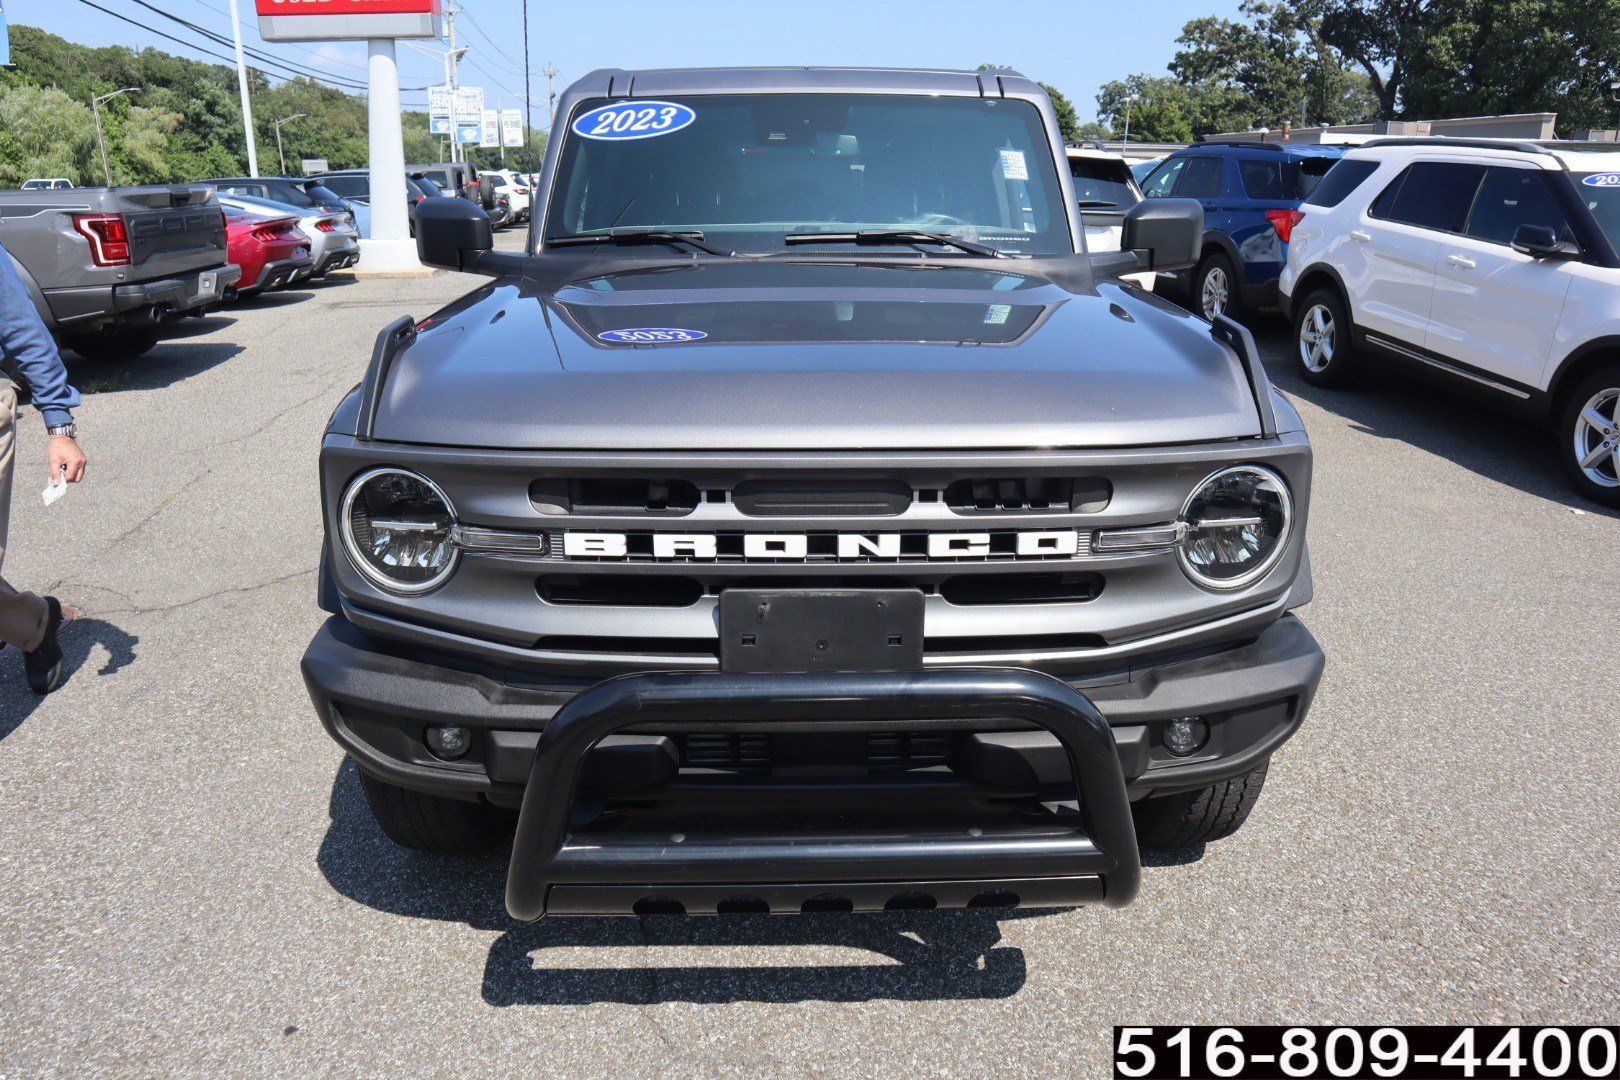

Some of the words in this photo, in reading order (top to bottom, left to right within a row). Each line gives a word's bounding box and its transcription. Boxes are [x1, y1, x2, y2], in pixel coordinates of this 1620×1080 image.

[590, 106, 678, 135] 2023
[1595, 174, 1620, 185] 20
[563, 530, 1078, 557] BRONCO
